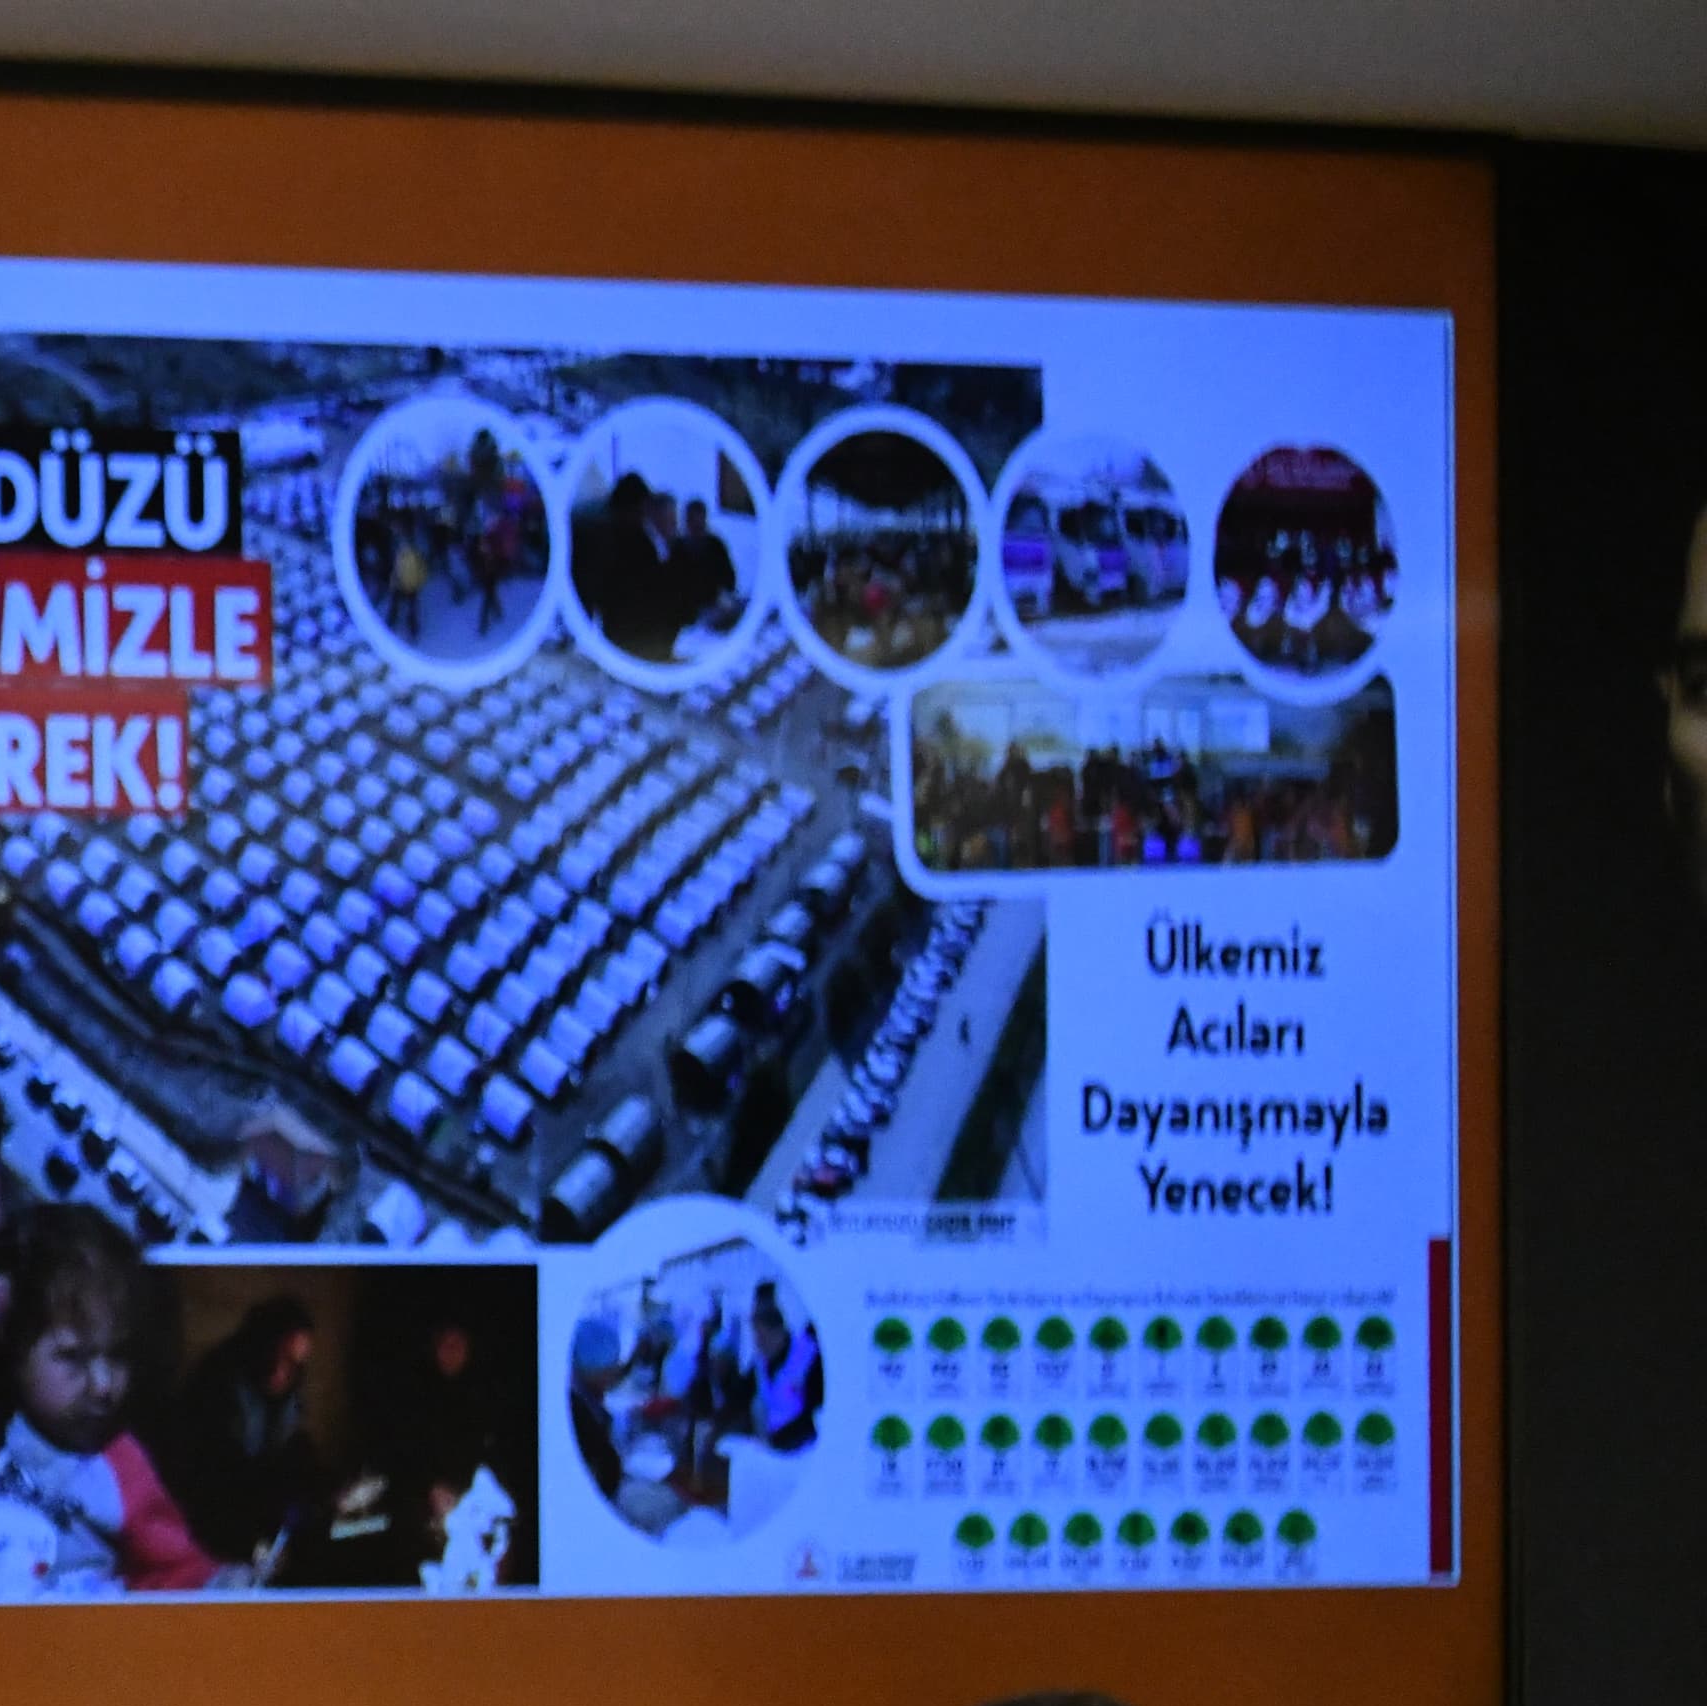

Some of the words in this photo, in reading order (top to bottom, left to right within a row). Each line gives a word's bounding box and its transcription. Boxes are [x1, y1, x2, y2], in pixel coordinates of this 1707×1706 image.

[1145, 906, 1326, 980] Ülkemiz
[1166, 1001, 1306, 1057] Acıları
[1082, 1081, 1391, 1150] Dayanışmayla
[1139, 1158, 1334, 1214] Yenecek!
